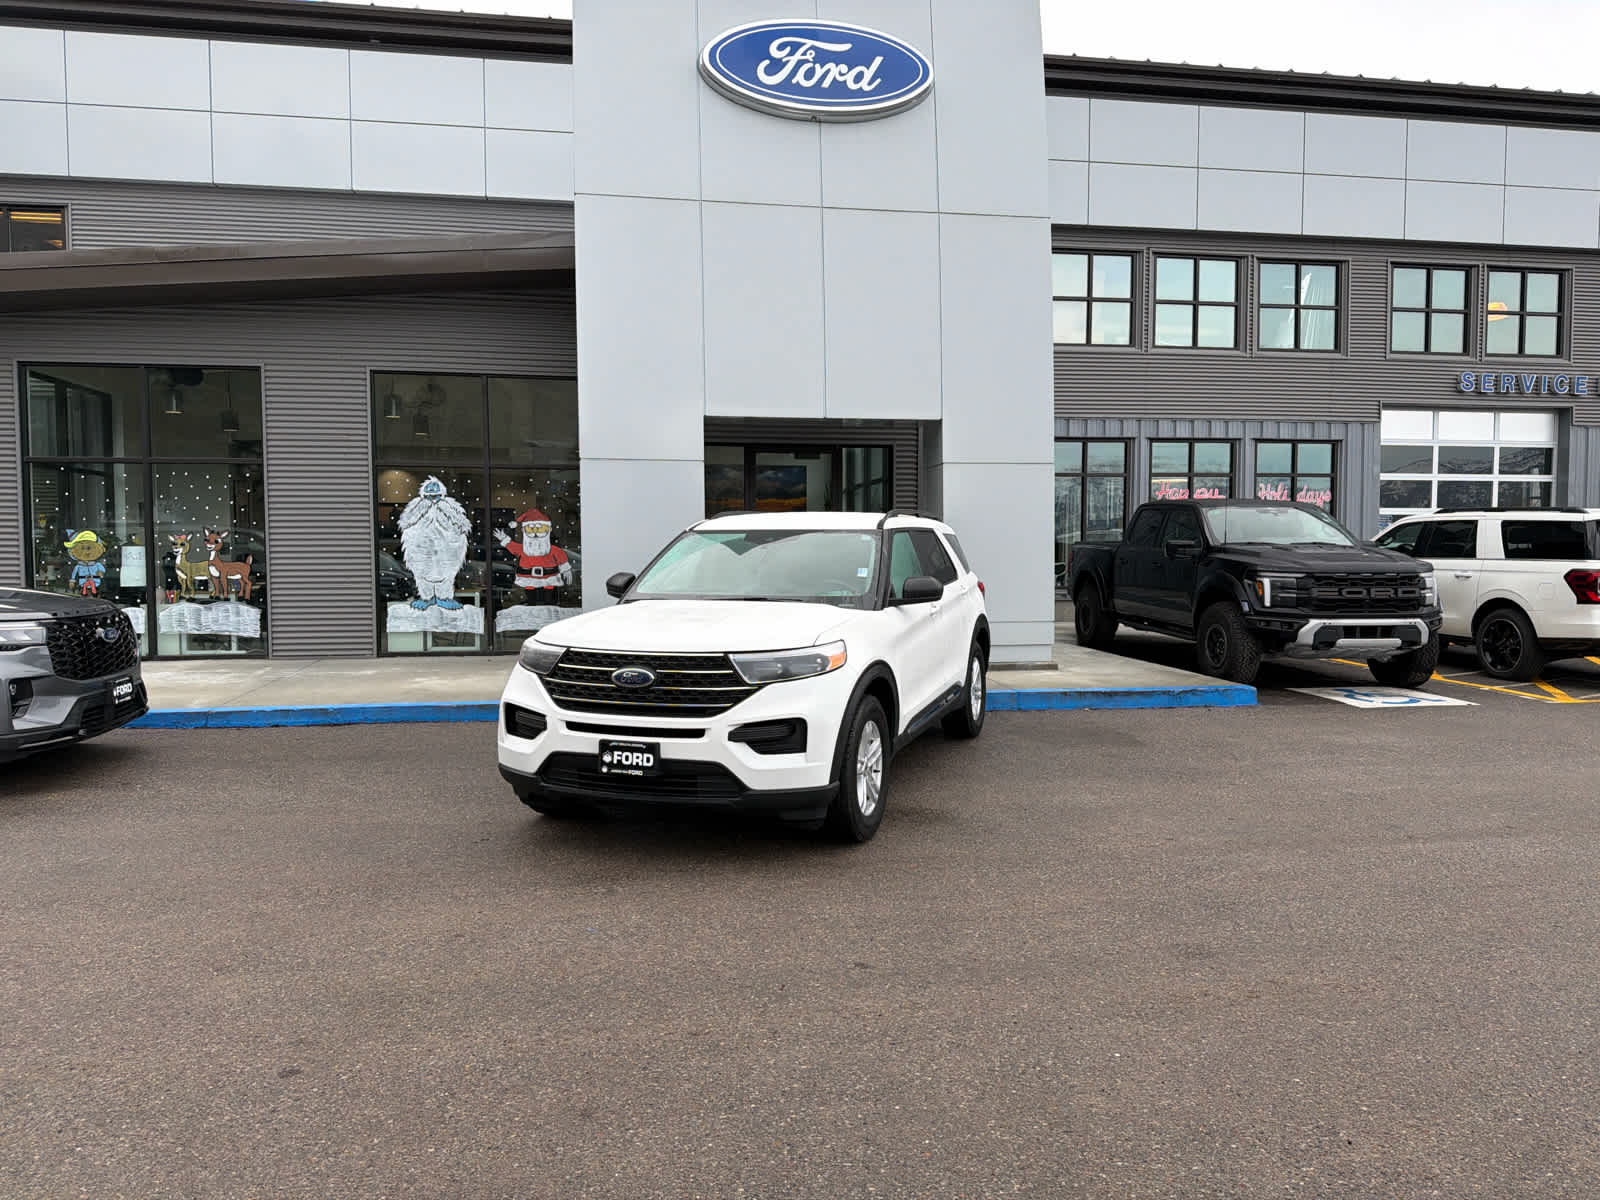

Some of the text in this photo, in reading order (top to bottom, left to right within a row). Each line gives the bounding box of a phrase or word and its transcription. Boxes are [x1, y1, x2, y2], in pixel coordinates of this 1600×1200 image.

[757, 37, 884, 91] Ford
[1460, 372, 1588, 394] SERVICE
[1311, 587, 1420, 599] FORD
[116, 683, 132, 696] FORD
[613, 750, 654, 767] FORD
